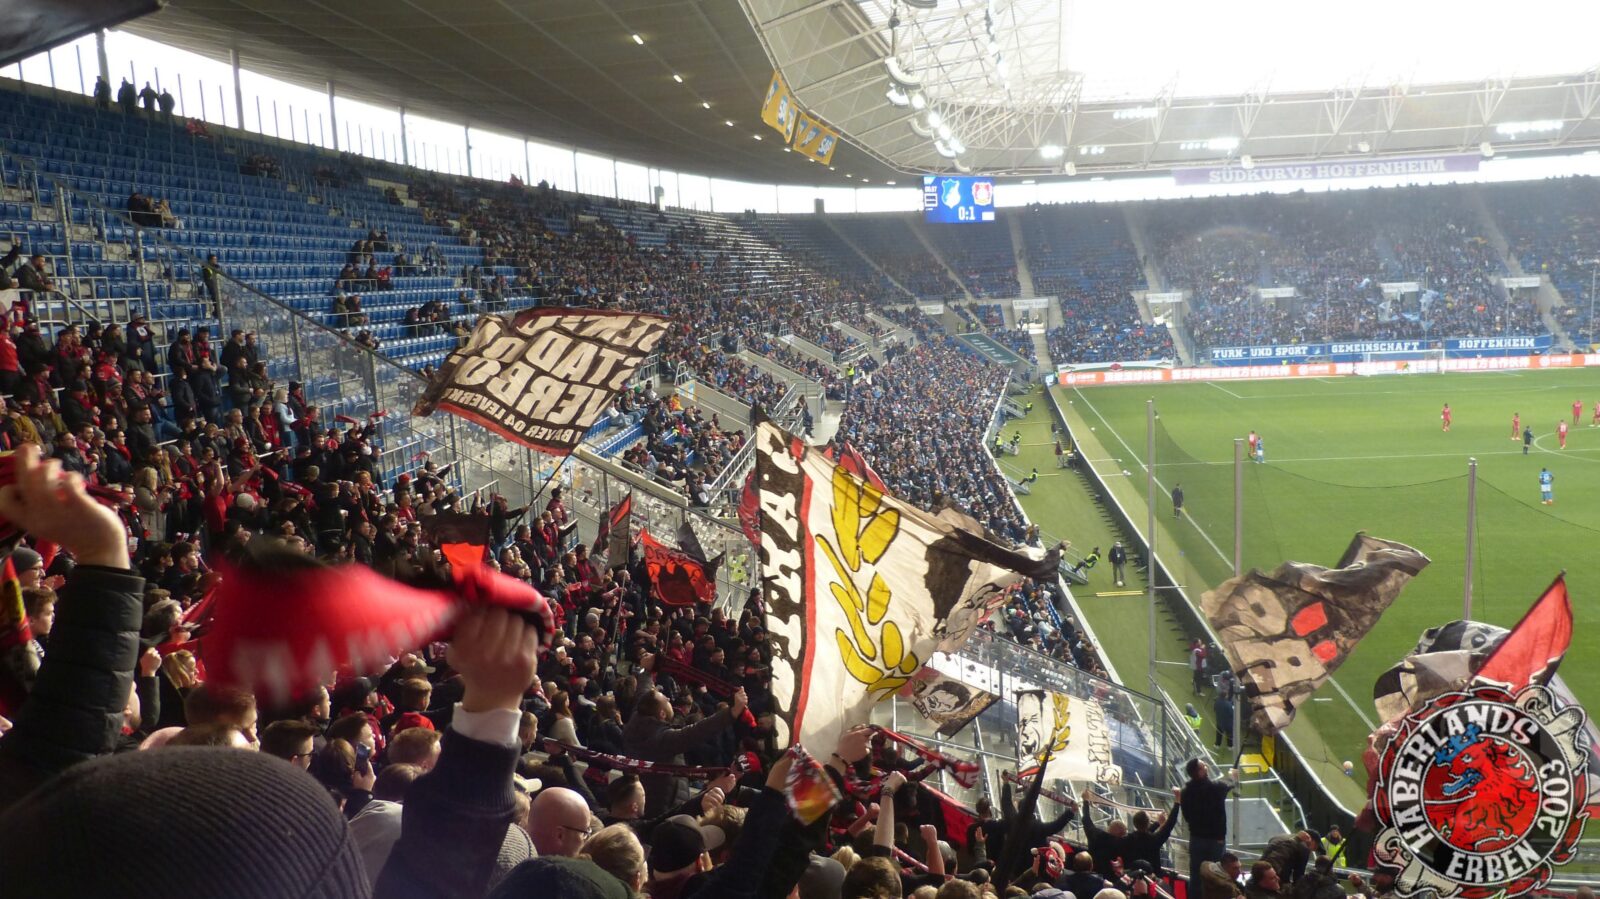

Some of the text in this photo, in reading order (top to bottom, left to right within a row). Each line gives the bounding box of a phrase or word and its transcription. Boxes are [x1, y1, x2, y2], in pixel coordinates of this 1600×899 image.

[1208, 159, 1446, 184] SÜDKURVE HOFFENHEIM
[958, 206, 976, 221] 0:1
[1331, 341, 1420, 353] GEMEINSCHAFT
[1458, 338, 1536, 349] HOFFENHEIM
[1250, 348, 1273, 357] UND
[1275, 346, 1309, 356] SPORT
